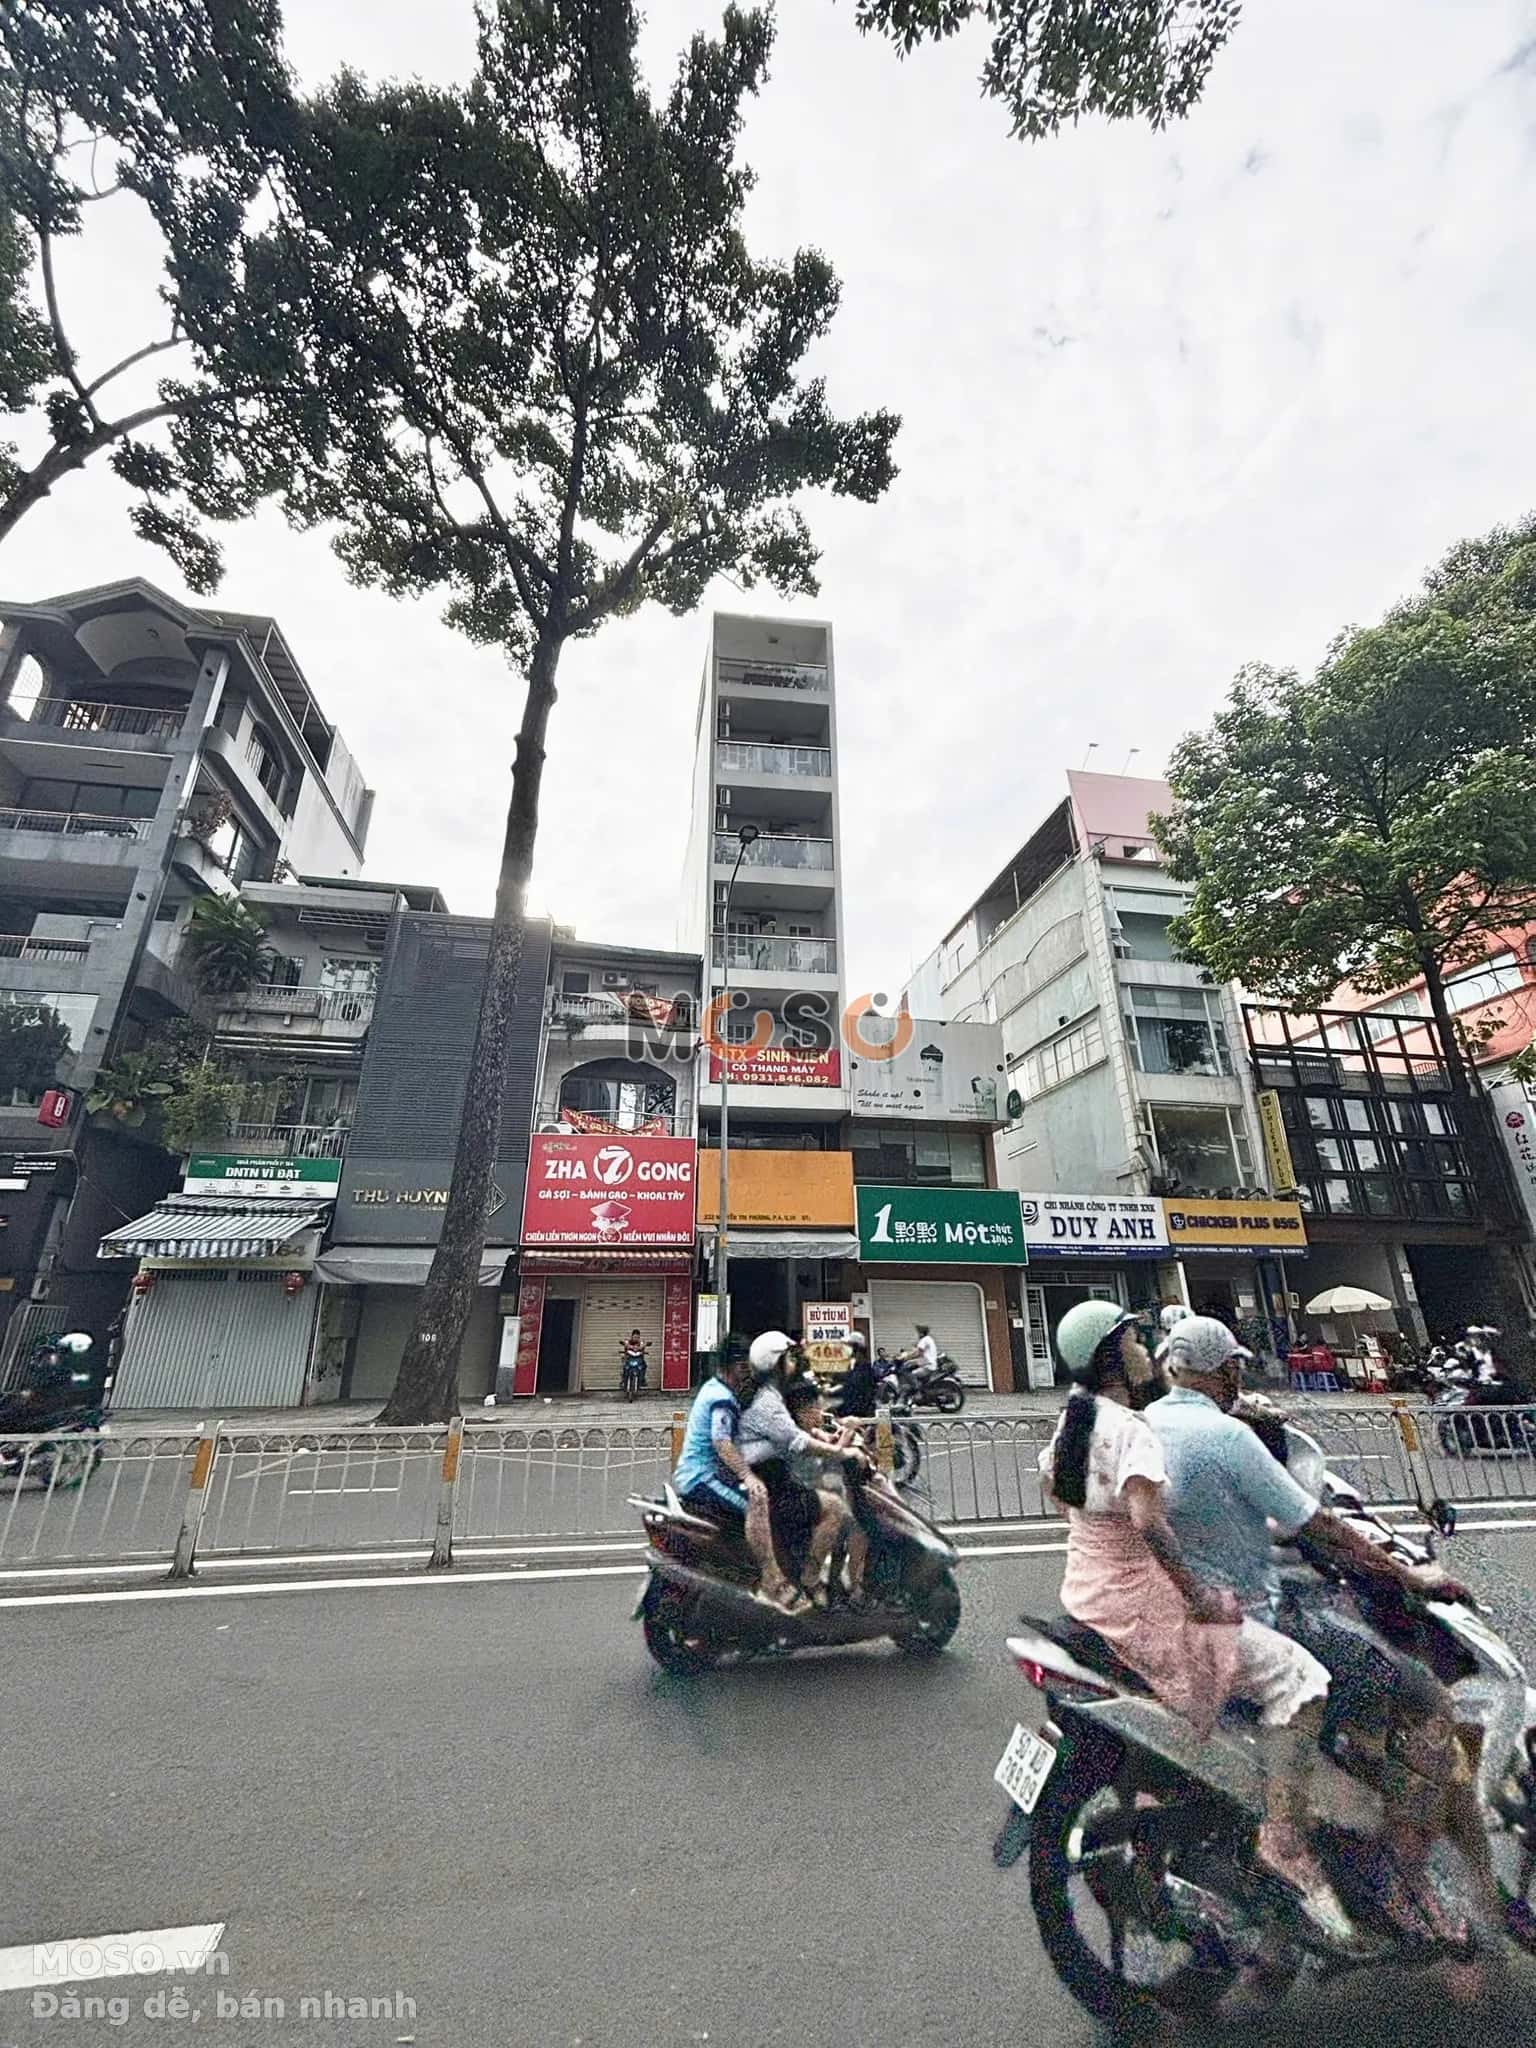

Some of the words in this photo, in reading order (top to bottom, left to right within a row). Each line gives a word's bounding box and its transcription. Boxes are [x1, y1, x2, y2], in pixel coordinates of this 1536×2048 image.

[757, 1049, 792, 1063] SINH
[731, 1061, 748, 1071] CÓ
[752, 1064, 789, 1073] THANG
[792, 1063, 816, 1074] MÁY
[225, 1167, 259, 1178] DNTN
[544, 1160, 587, 1180] ZHA
[637, 1162, 691, 1182] GONG
[396, 1188, 451, 1203] HUỲN
[637, 1191, 666, 1201] KHOAI
[1050, 1216, 1098, 1238] DUY
[1107, 1217, 1156, 1239] ANH
[1187, 1215, 1238, 1229] CHICKEN
[1240, 1216, 1270, 1229] PLUS
